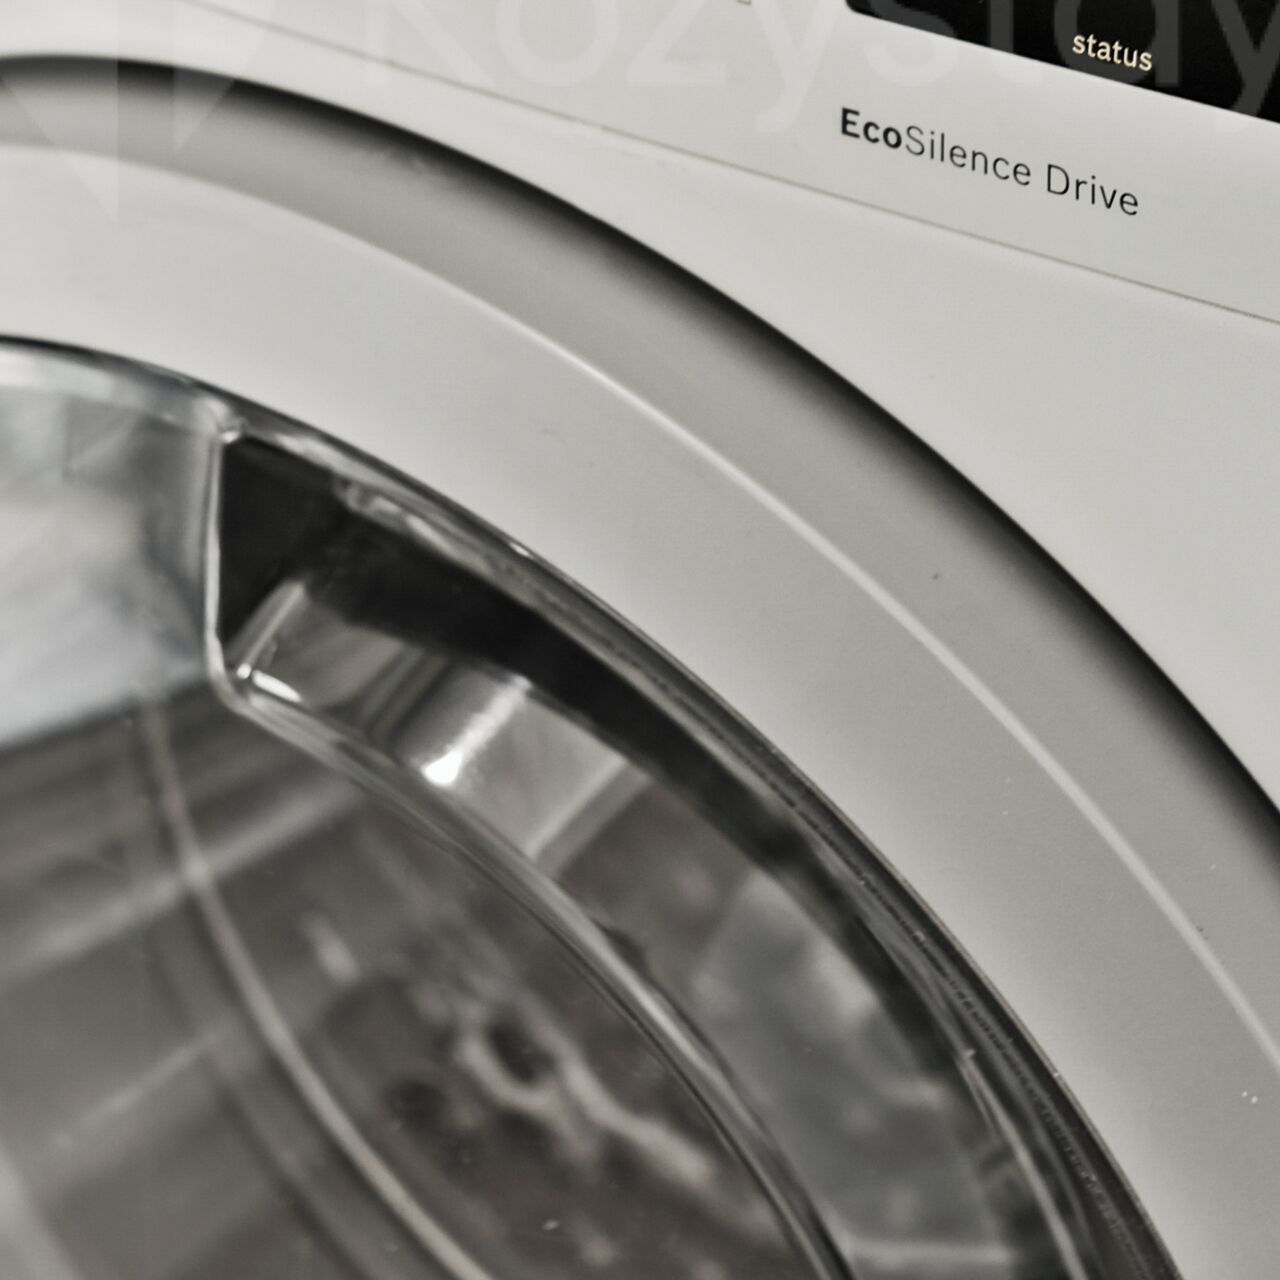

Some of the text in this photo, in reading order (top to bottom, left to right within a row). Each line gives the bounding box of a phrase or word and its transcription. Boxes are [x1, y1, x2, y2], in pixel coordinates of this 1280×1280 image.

[1072, 31, 1153, 72] status
[839, 107, 1140, 216] EcoSilence Drive
